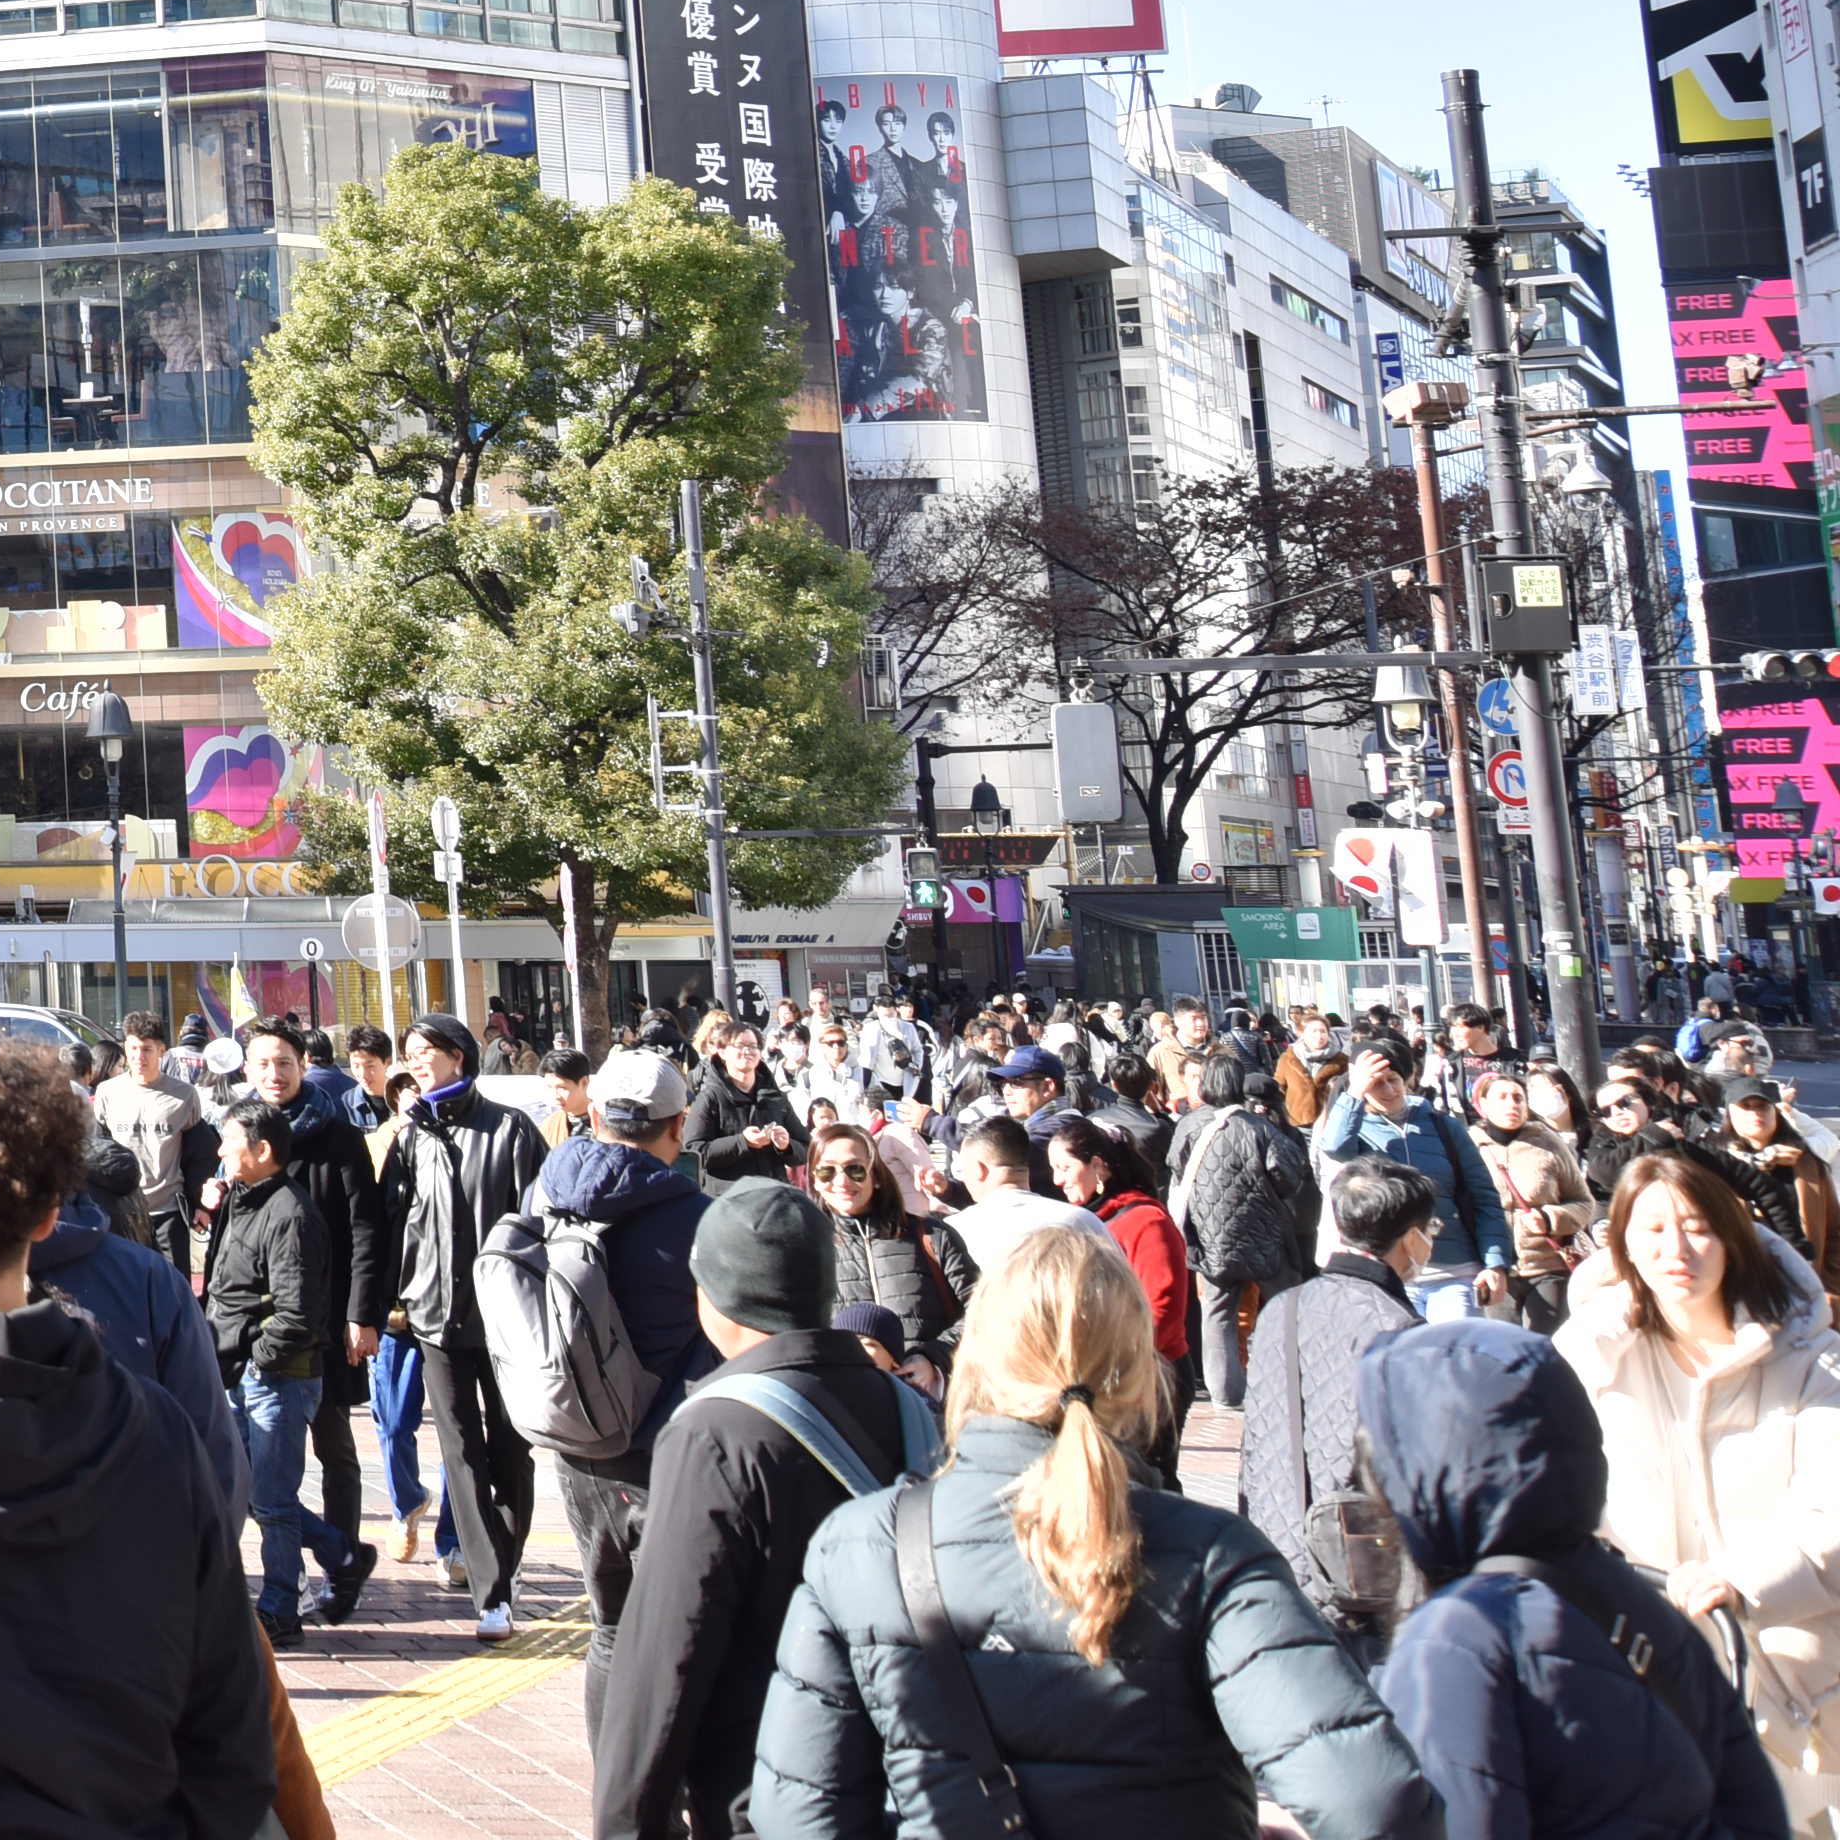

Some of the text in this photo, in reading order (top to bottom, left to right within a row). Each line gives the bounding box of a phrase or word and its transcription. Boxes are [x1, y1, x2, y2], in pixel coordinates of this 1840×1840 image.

[848, 144, 961, 184] 09
[1800, 161, 1825, 210] 7F
[839, 226, 970, 268] NTER
[1675, 292, 1735, 311] FREE
[835, 315, 978, 358] ALE
[1698, 328, 1757, 345] FREE
[1685, 366, 1730, 383] FRE
[1693, 437, 1753, 455] FREE
[19, 515, 119, 533] PROVENCE
[1518, 570, 1556, 578] CCTV
[1519, 586, 1559, 595] POLICE
[1584, 632, 1610, 707] 渋谷駅前
[19, 680, 103, 720] Café
[1731, 737, 1794, 755] FREE
[906, 912, 935, 922] SHIBUY
[1240, 912, 1286, 923] SMOKING
[1262, 922, 1288, 932] AREA
[730, 934, 771, 944] HIBUYA
[775, 934, 820, 944] EKIMAE
